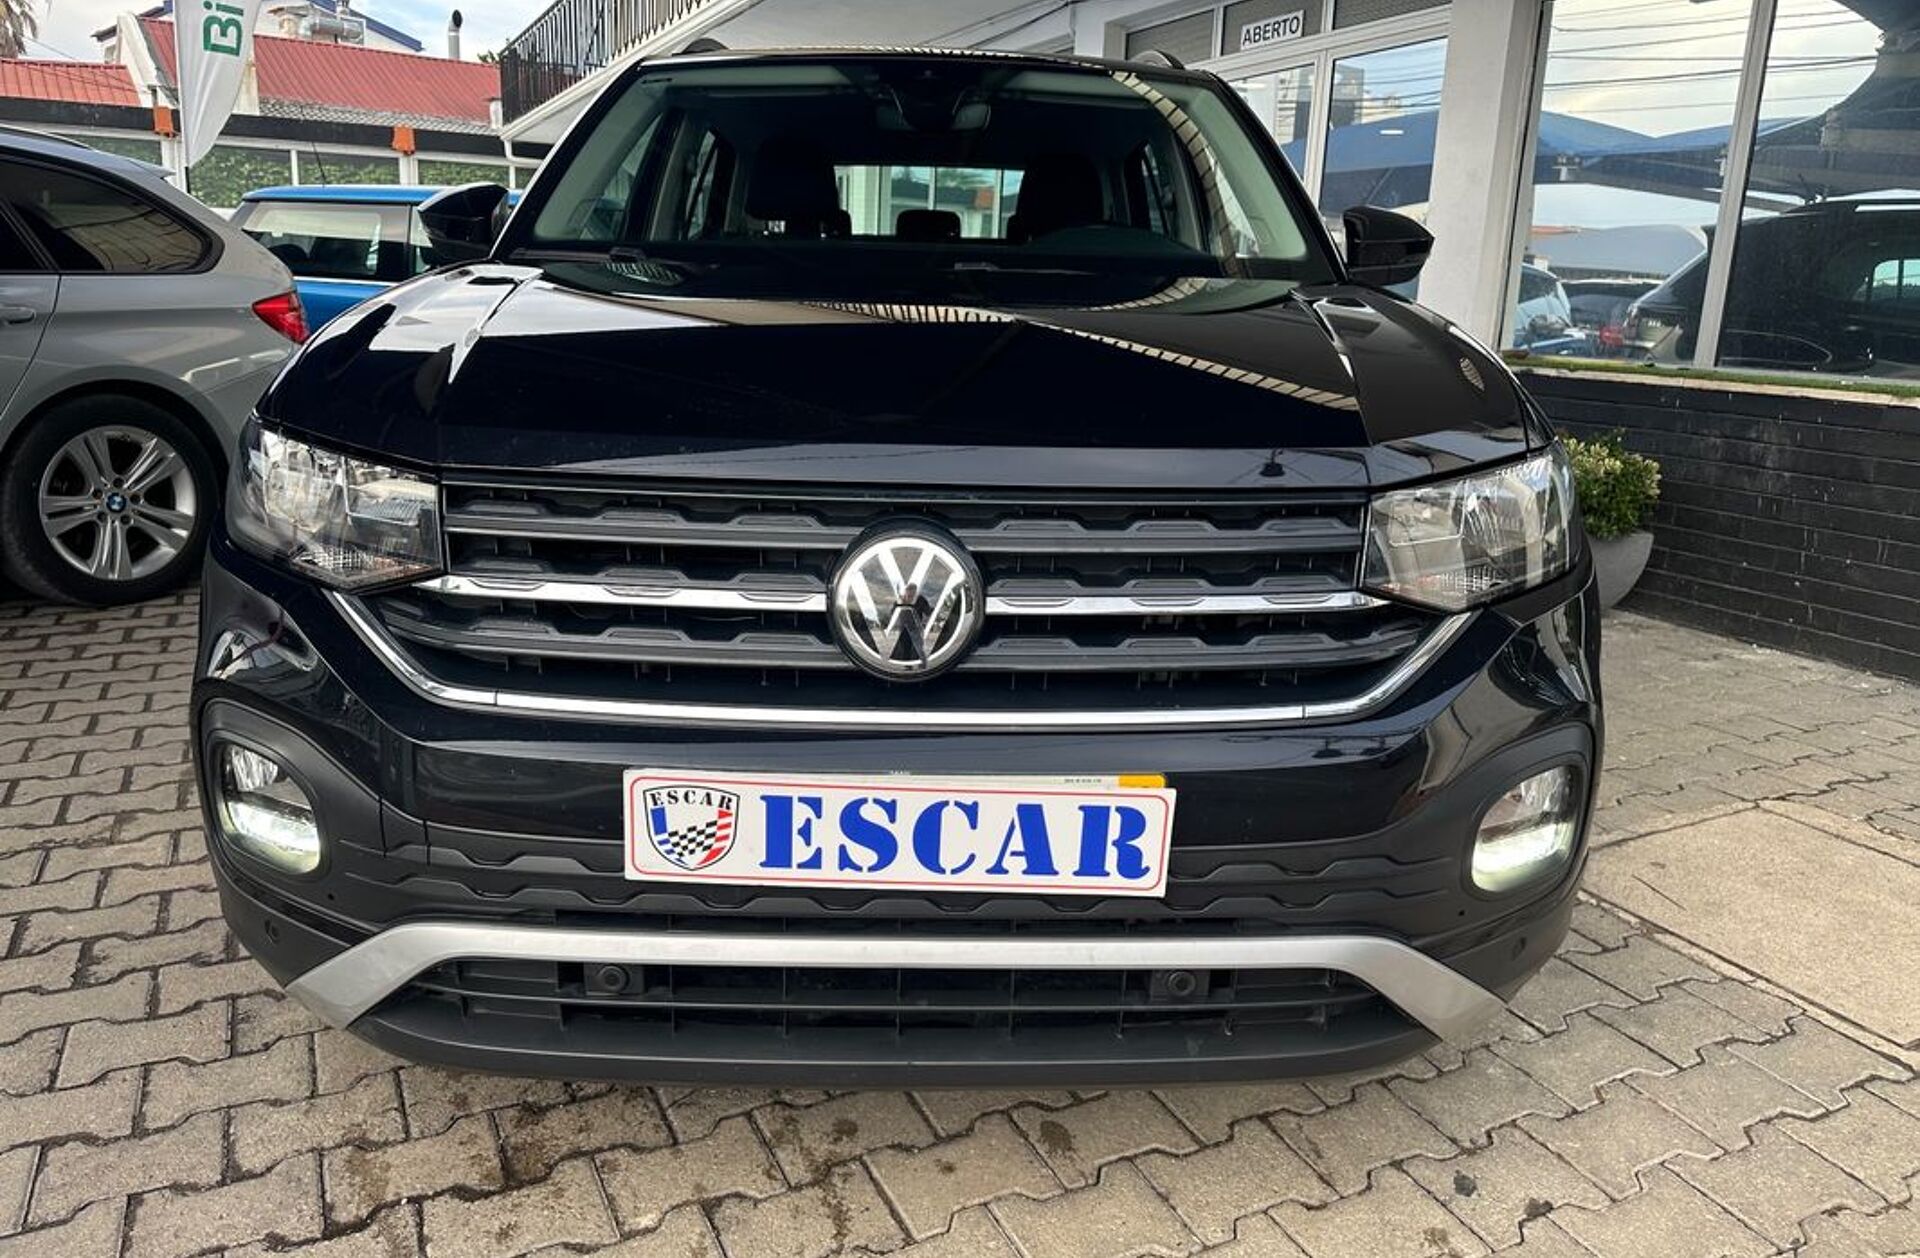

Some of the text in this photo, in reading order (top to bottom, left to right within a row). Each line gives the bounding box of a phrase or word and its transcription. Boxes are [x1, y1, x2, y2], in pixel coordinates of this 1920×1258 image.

[203, 1, 244, 57] Bi
[1242, 16, 1300, 46] ABERTO
[650, 789, 732, 810] ESCAR
[759, 795, 1150, 880] ESCAR
